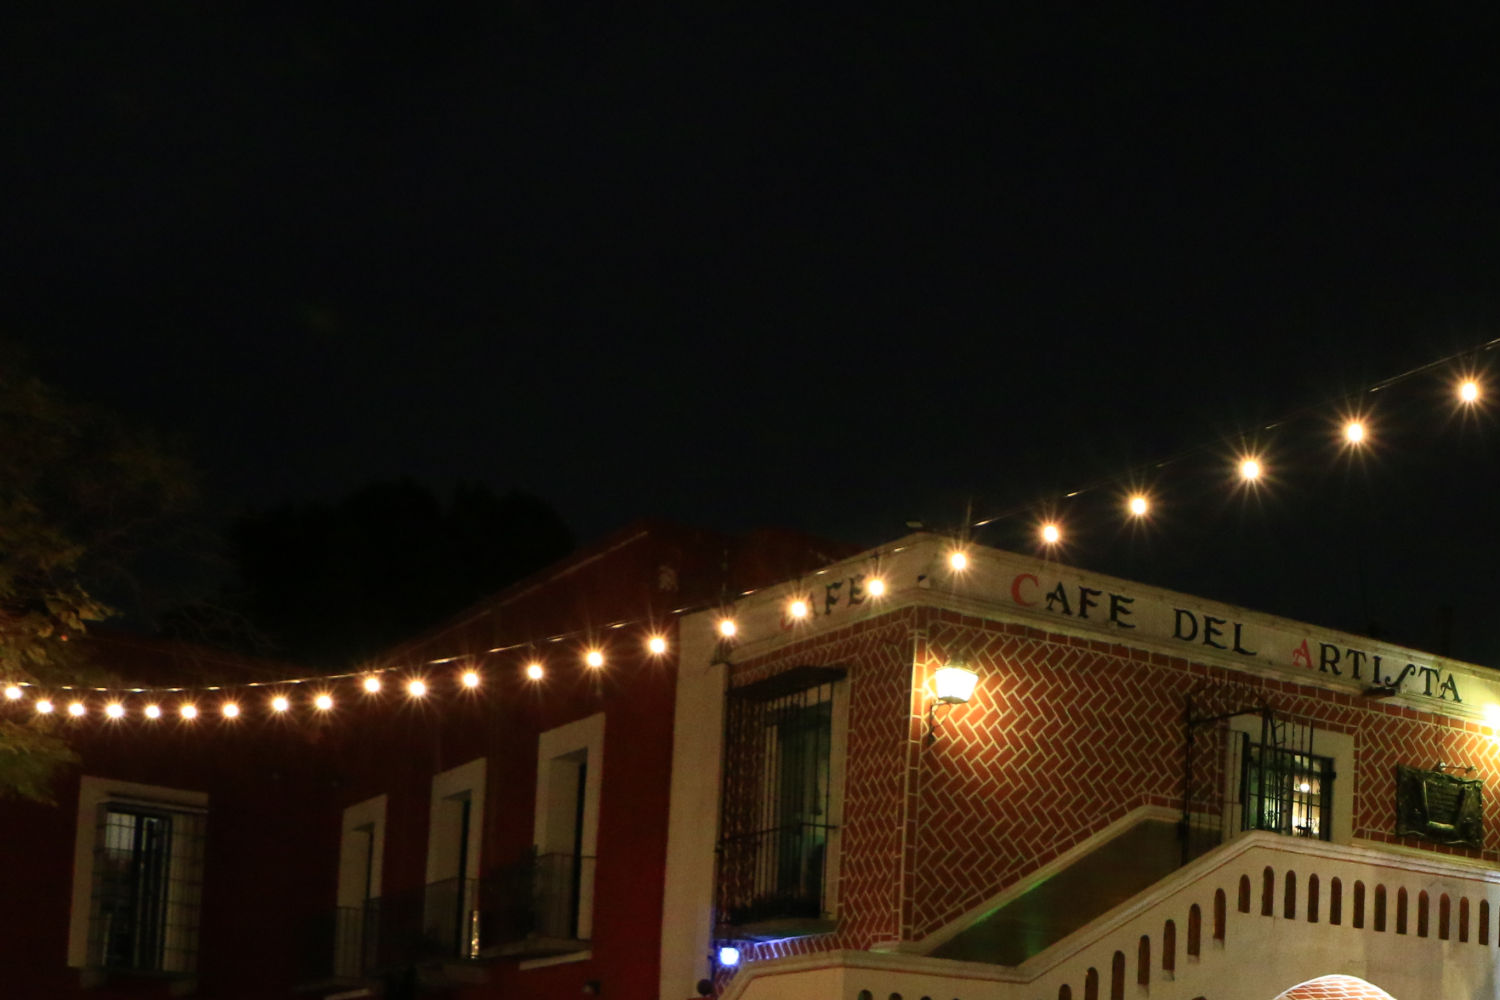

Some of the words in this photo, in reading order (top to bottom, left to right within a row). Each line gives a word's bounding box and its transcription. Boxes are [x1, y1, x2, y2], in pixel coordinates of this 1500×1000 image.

[1010, 573, 1136, 629] CAFE
[1172, 608, 1257, 656] DEL
[1292, 638, 1462, 703] ARTISTA
